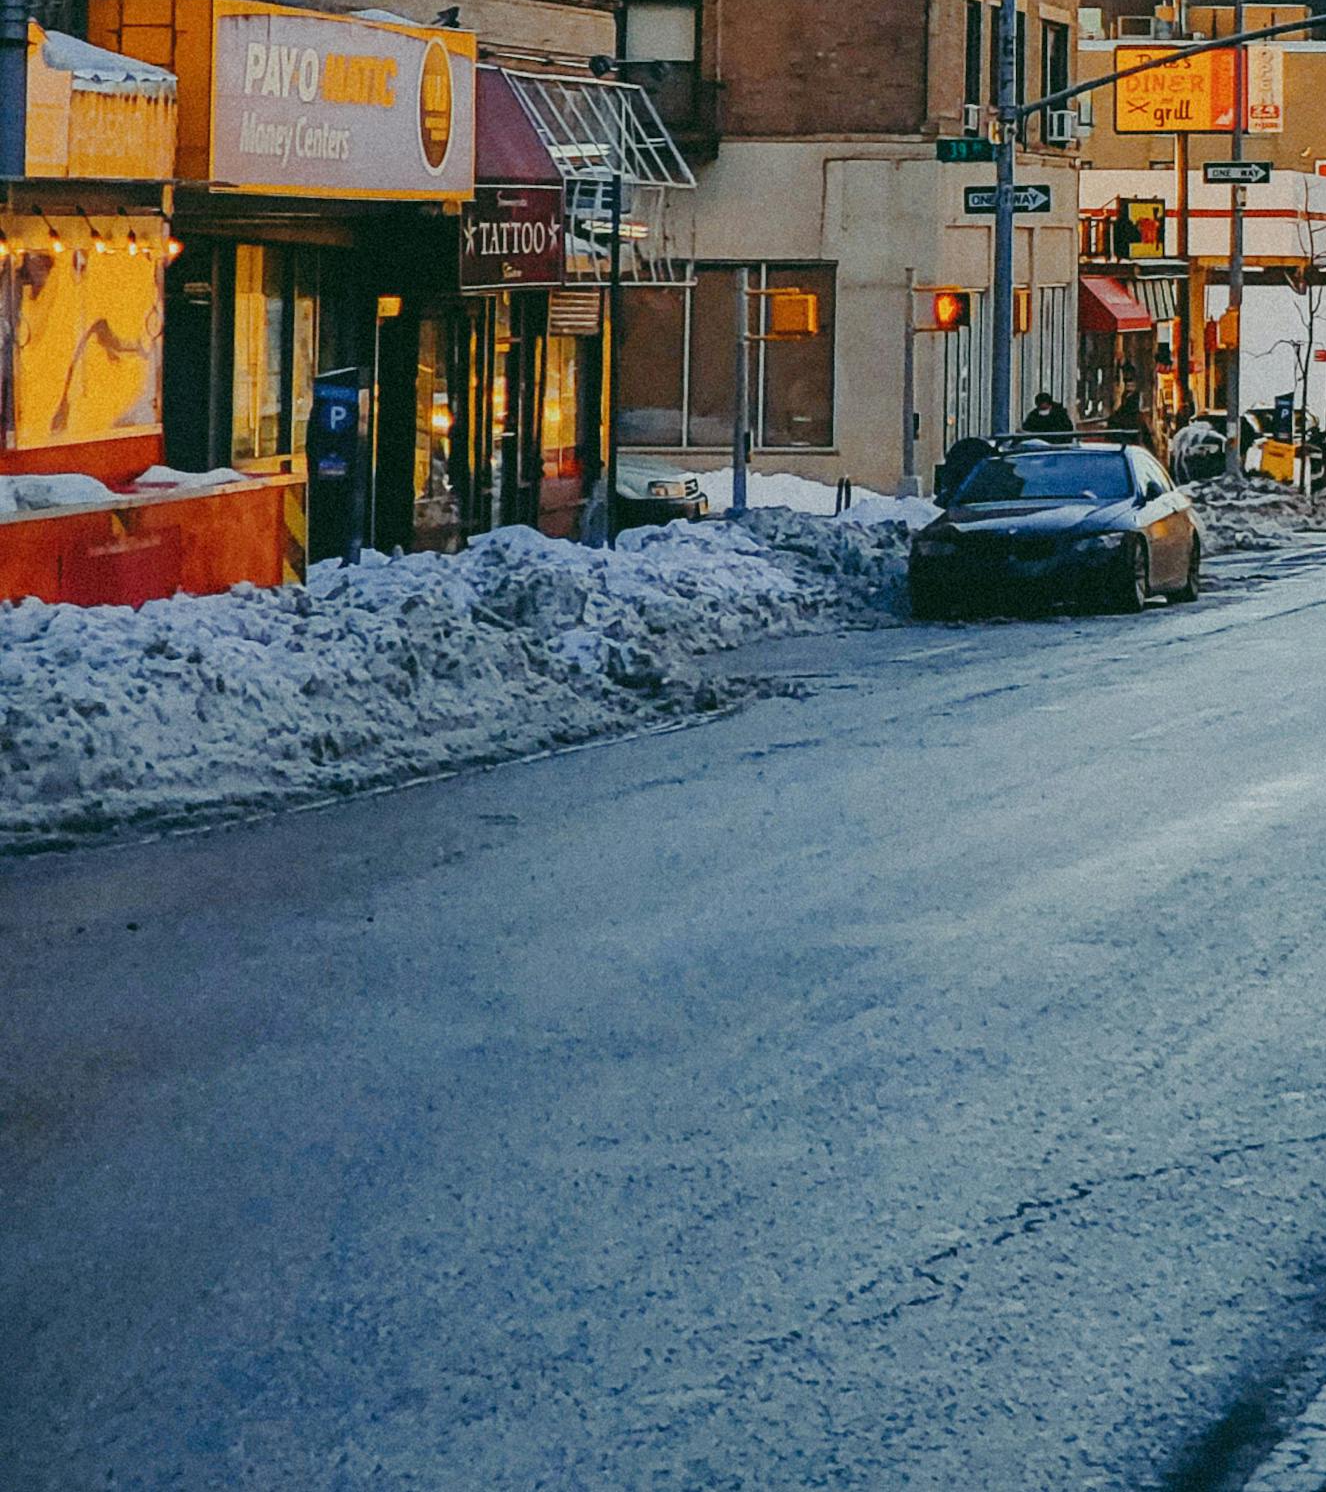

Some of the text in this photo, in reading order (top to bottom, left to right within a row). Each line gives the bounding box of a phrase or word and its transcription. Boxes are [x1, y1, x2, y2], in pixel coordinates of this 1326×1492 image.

[1153, 99, 1193, 127] grill
[239, 110, 350, 169] Money Centers
[1212, 167, 1260, 177] ONE WAY
[479, 221, 546, 255] TATTOO
[330, 405, 347, 430] P
